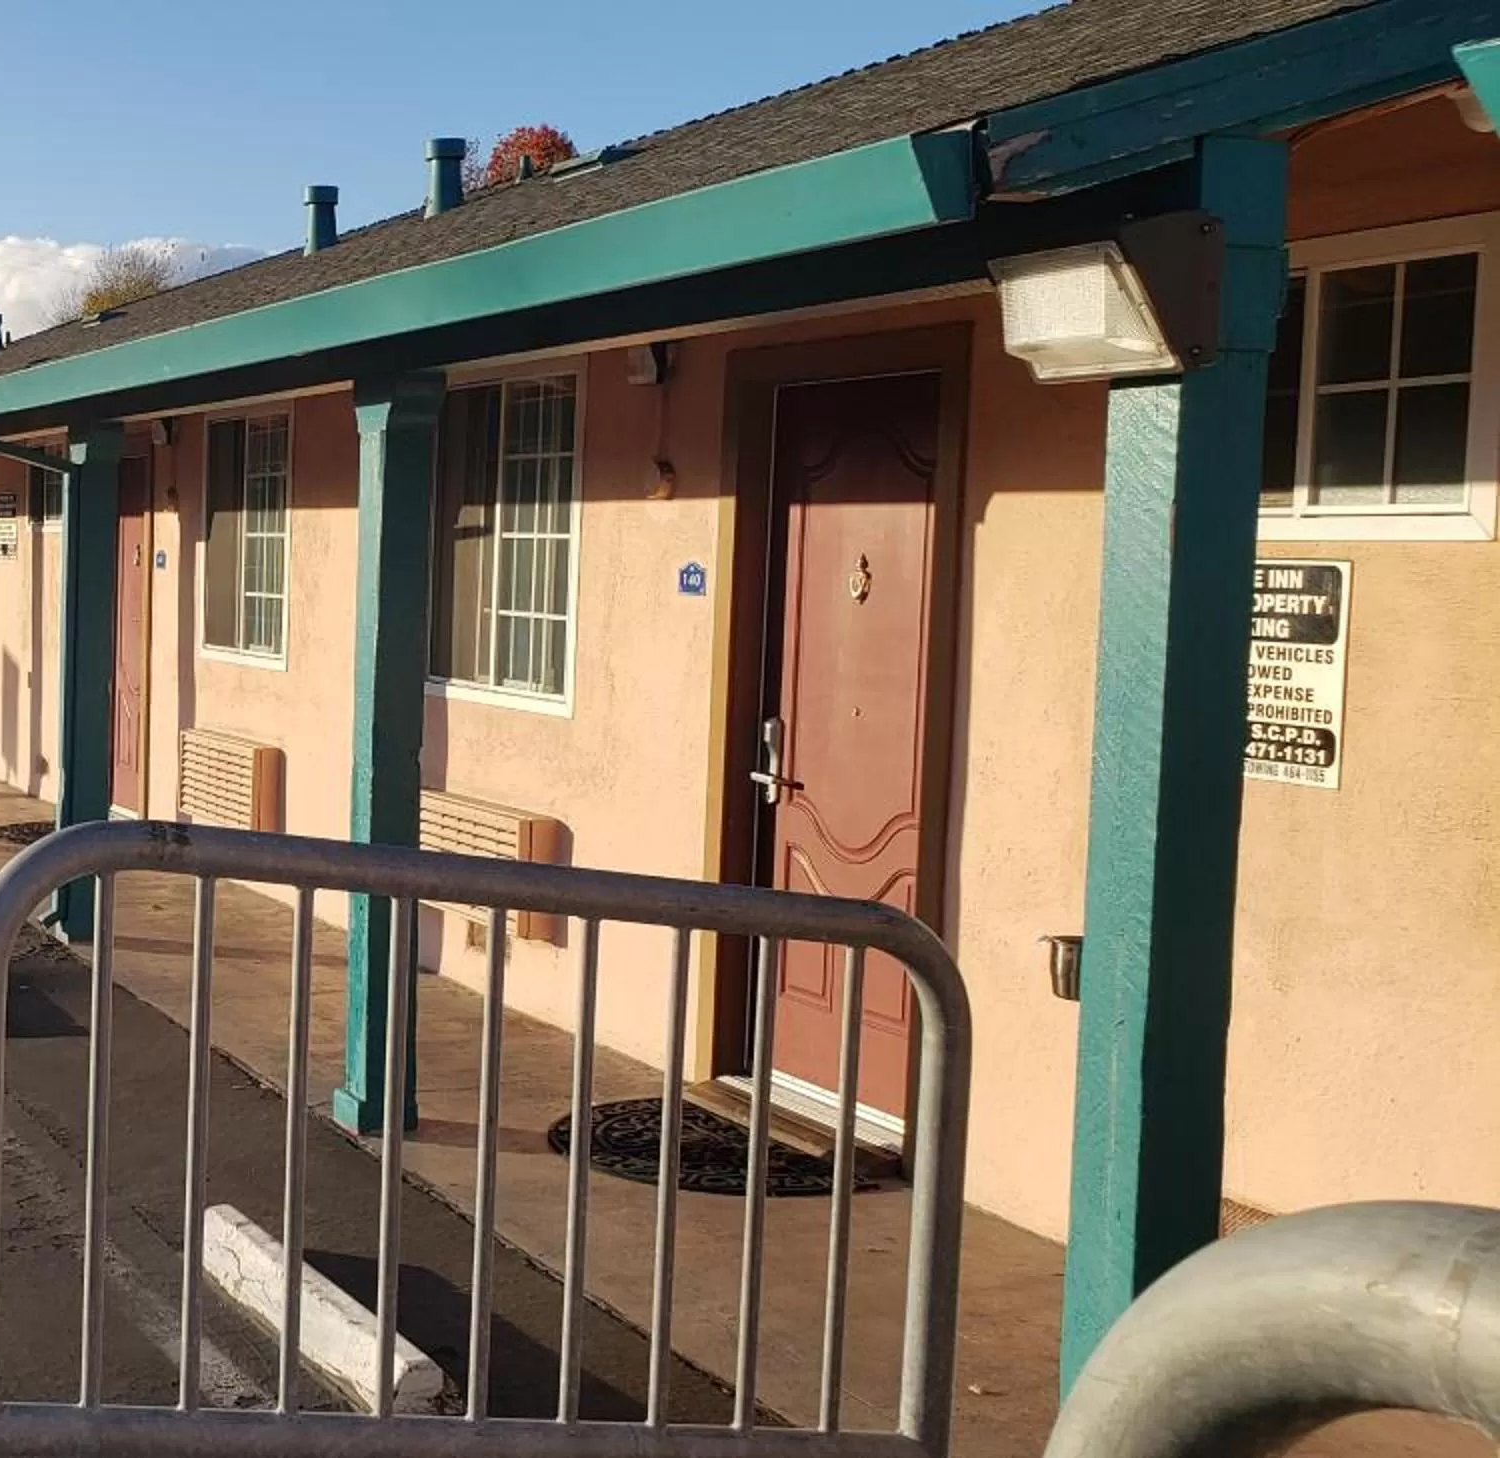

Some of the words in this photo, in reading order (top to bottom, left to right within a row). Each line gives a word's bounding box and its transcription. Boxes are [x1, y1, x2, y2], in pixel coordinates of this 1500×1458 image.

[1268, 569, 1304, 589] INN
[1255, 645, 1335, 665] VEHICLES
[1251, 723, 1321, 747] S.C.P.D.
[1245, 741, 1326, 765] 471-1131
